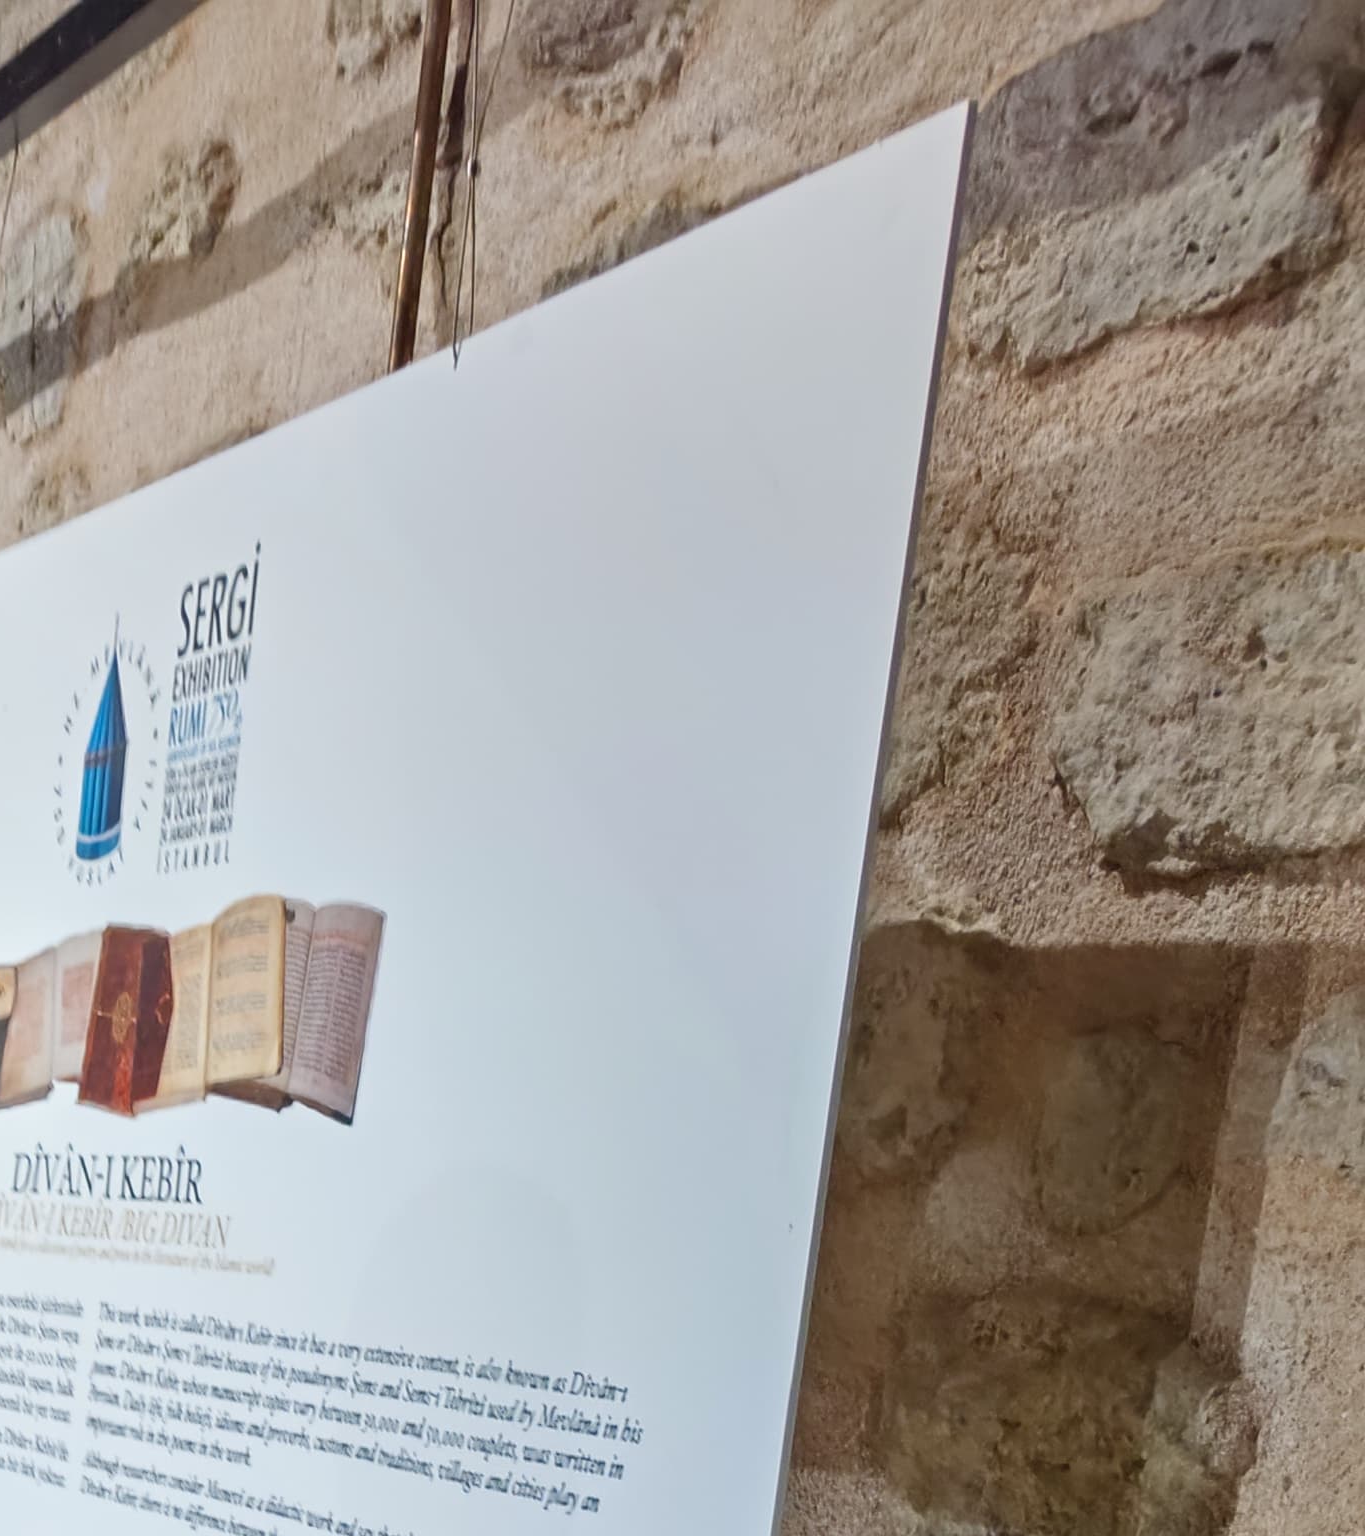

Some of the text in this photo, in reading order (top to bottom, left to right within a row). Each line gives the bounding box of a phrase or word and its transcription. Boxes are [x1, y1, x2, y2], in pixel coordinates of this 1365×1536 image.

[177, 540, 260, 657] SERGİ
[172, 646, 251, 700] EXHIBITION
[167, 700, 207, 745] RUMI
[12, 1143, 201, 1203] DÎVÂN-I KEBÎR
[308, 1333, 327, 1355] has
[326, 1342, 336, 1357] a
[337, 1342, 362, 1367] very
[363, 1346, 414, 1368] extensive
[462, 1354, 475, 1378] is
[474, 1357, 502, 1382] also
[504, 1360, 550, 1390] known
[550, 1376, 568, 1394] as
[270, 1358, 288, 1386] the
[378, 1378, 403, 1400] and
[486, 1399, 519, 1422] used
[517, 1400, 535, 1432] by
[601, 1415, 618, 1440] in
[619, 1417, 643, 1444] his
[292, 1399, 316, 1424] vary
[318, 1399, 362, 1425] between
[400, 1417, 426, 1439] and
[521, 1445, 551, 1465] was
[553, 1449, 606, 1475] written
[607, 1454, 624, 1480] in
[354, 1442, 379, 1462] and
[437, 1459, 483, 1493] villages
[483, 1471, 513, 1494] and
[510, 1474, 546, 1502] cities
[542, 1481, 578, 1515] play
[580, 1495, 600, 1513] an
[305, 1510, 334, 1532] work
